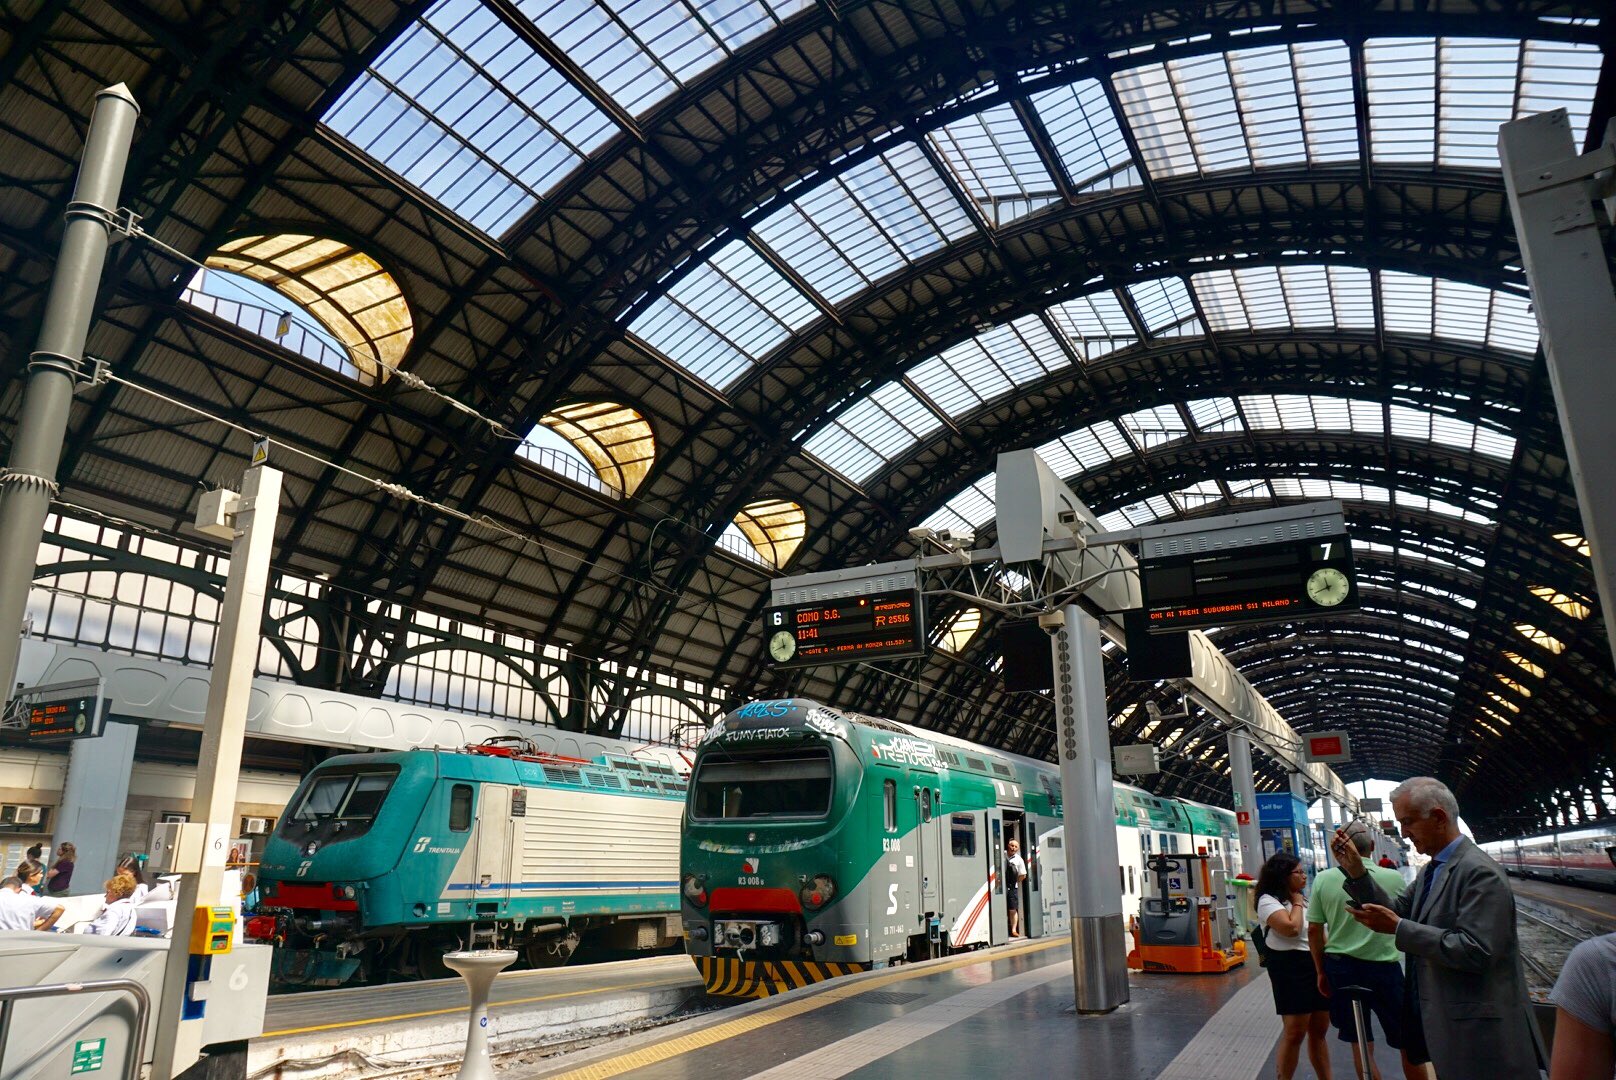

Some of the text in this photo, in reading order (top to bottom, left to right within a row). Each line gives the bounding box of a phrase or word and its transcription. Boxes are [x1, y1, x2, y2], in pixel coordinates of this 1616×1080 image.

[1320, 543, 1332, 560] 7
[1166, 610, 1175, 619] AI
[1178, 608, 1200, 617] TRENI
[1203, 604, 1244, 615] SUBURBANI
[1262, 598, 1291, 609] MILANO
[773, 612, 782, 626] 6
[797, 612, 819, 623] COMO
[888, 614, 910, 624] 25516
[798, 628, 819, 640] 11:41
[80, 700, 85, 709] 5
[154, 837, 162, 851] 6
[214, 837, 222, 850] 6
[891, 838, 901, 851] 008
[748, 876, 760, 885] 008
[886, 883, 899, 916] S
[229, 964, 248, 991] 6
